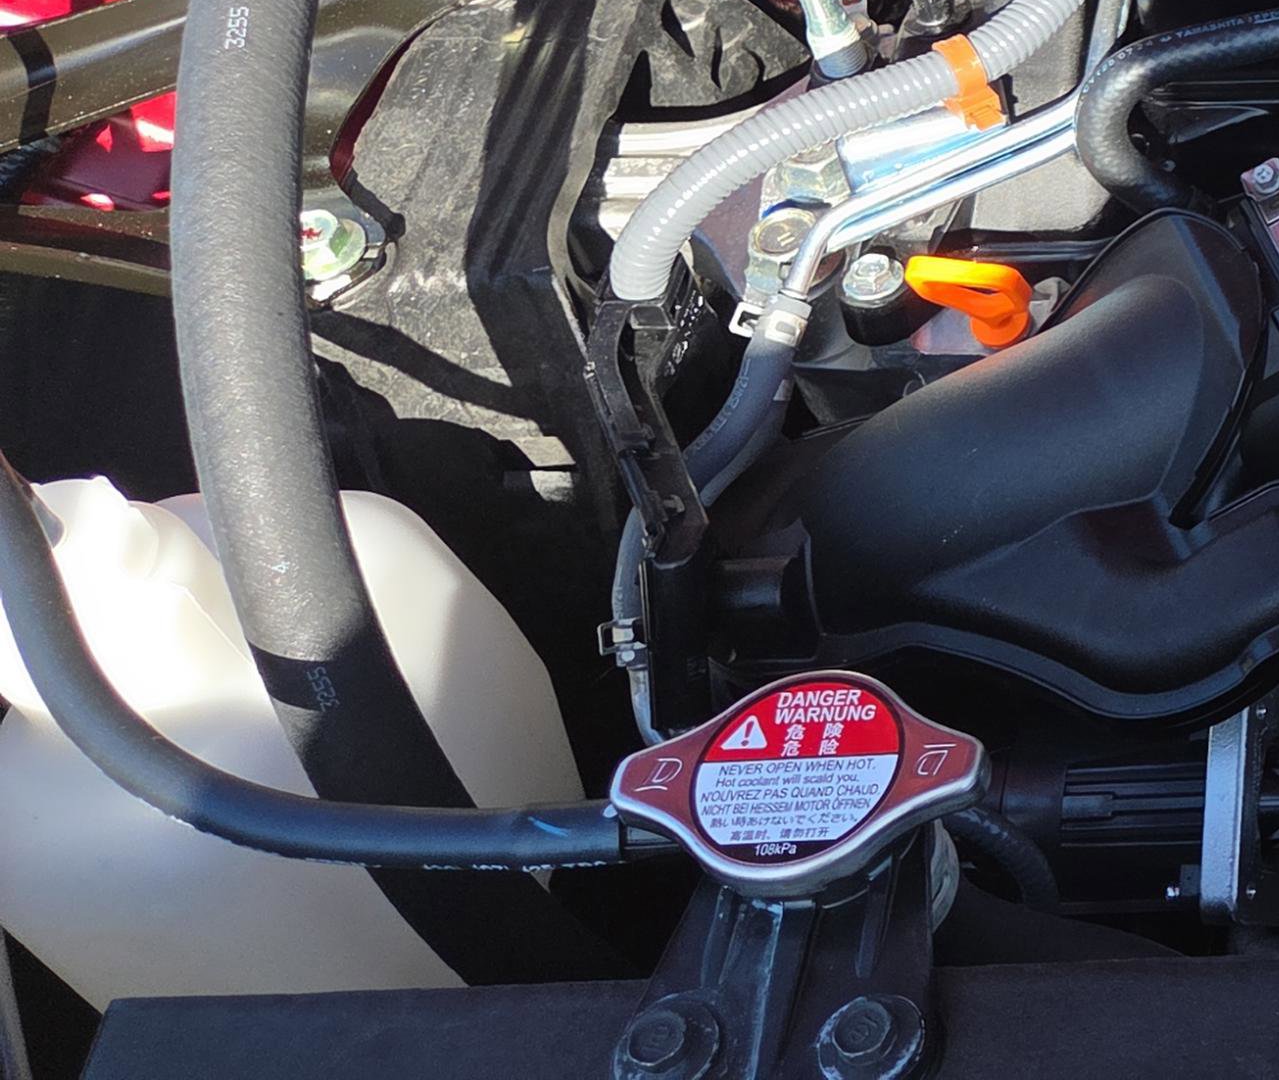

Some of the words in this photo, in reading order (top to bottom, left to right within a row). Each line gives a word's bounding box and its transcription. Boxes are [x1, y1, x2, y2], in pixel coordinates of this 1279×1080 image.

[224, 6, 250, 50] 3255
[1175, 17, 1245, 40] YAMASHITA
[306, 666, 340, 712] 3255
[777, 689, 861, 708] DANGER
[774, 704, 877, 725] WARNUNG
[719, 764, 763, 776] NEVER
[766, 761, 801, 774] OPEN
[805, 759, 843, 772] WHEN
[845, 758, 876, 770] HOT.
[716, 777, 736, 787] Hot
[738, 775, 779, 787] coolant
[782, 774, 801, 785] will
[803, 773, 834, 785] scald
[836, 774, 860, 784] you.
[701, 788, 760, 803] N'OUVREZ
[763, 788, 787, 799] PAS
[790, 786, 833, 798] QUAND
[701, 805, 731, 816] NICHT
[733, 804, 749, 814] BEI
[751, 802, 793, 814] HEISSEM
[795, 800, 830, 811] MOTOR
[754, 843, 798, 856] 108kPa
